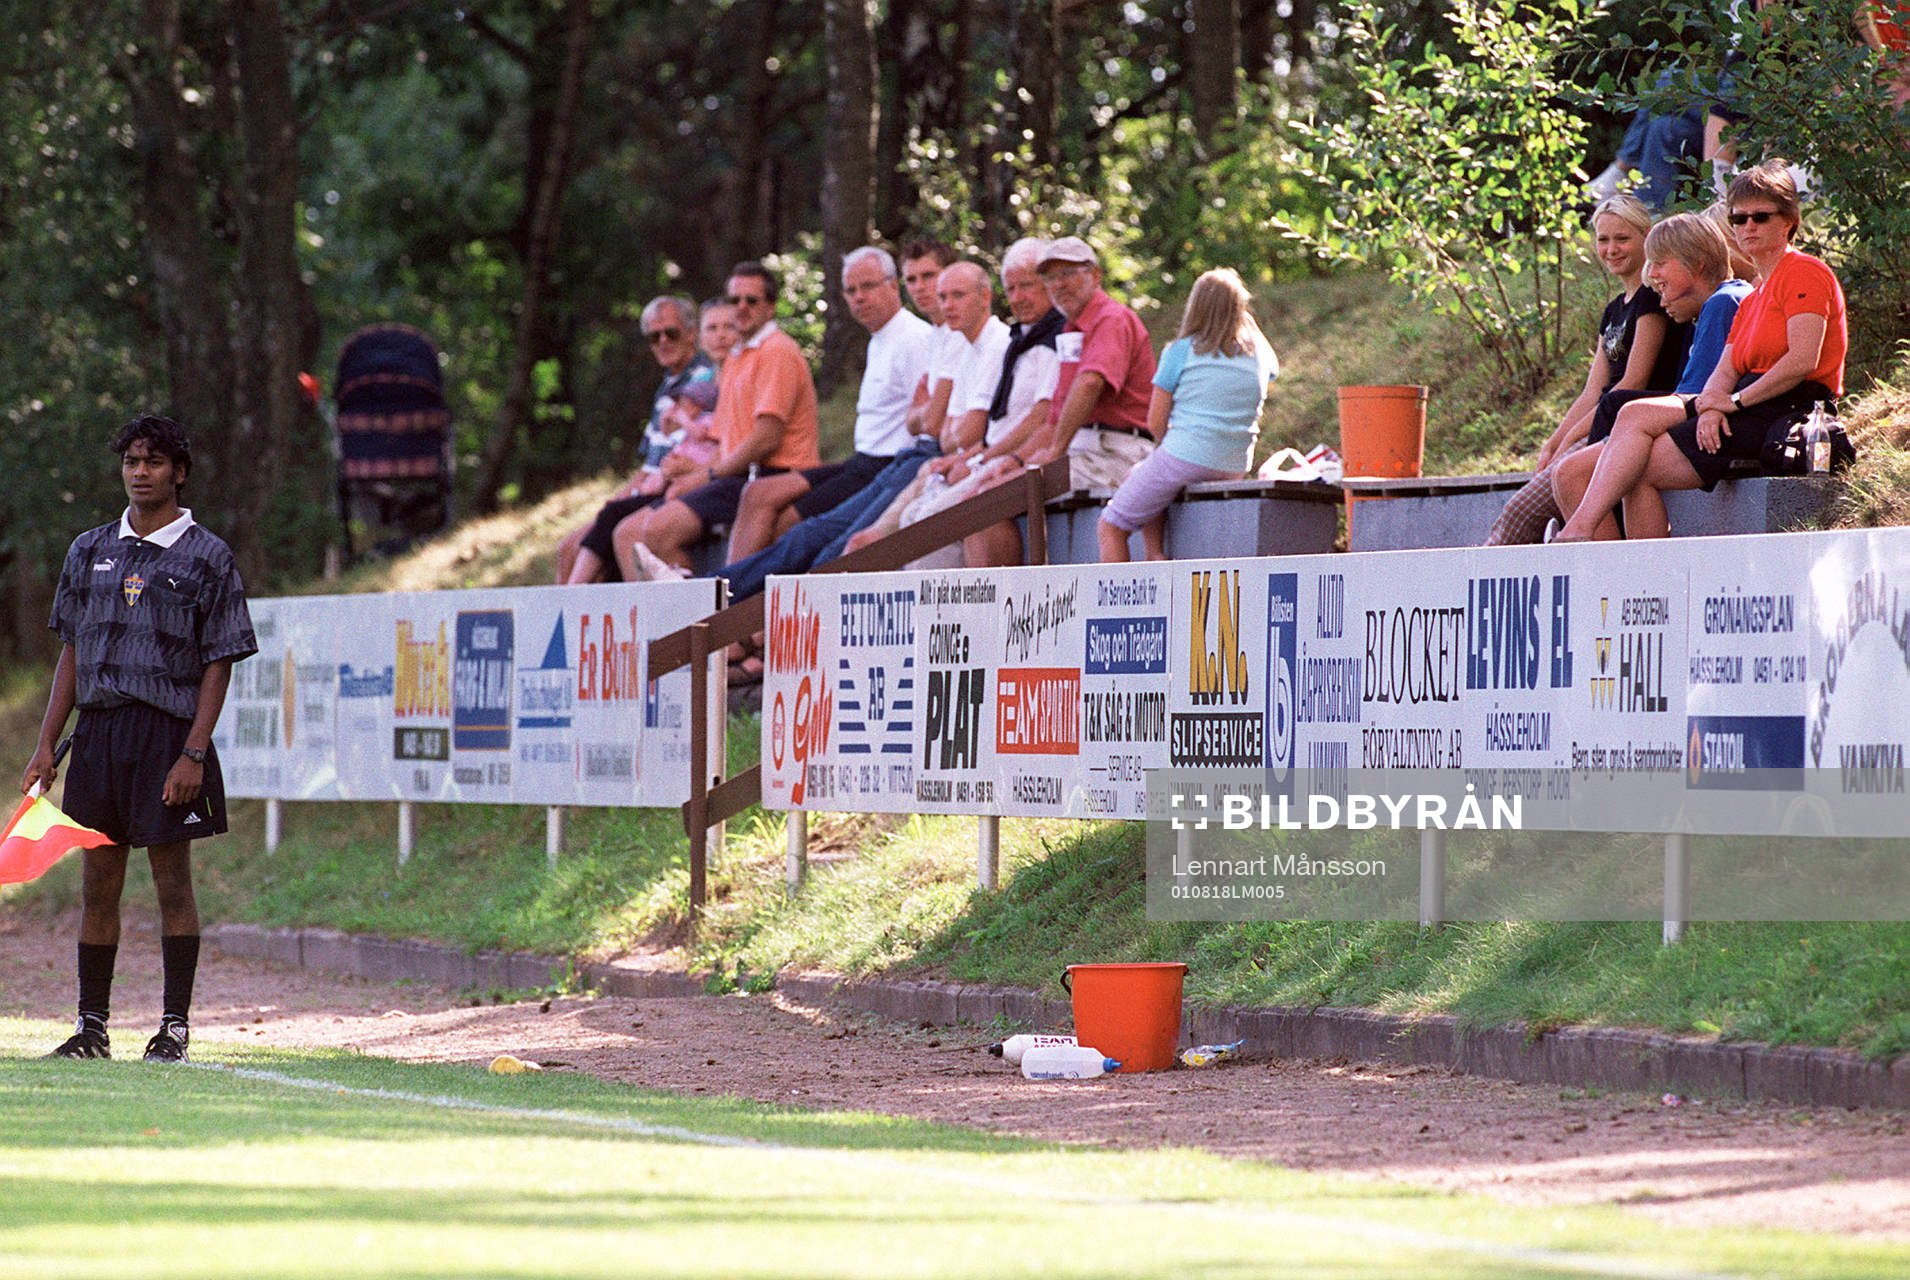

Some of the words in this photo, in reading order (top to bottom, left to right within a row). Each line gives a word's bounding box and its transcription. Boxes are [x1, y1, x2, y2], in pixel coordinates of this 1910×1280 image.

[951, 578, 962, 605] och
[963, 576, 996, 604] ventilation
[1109, 578, 1131, 607] Service
[1316, 573, 1345, 640] ALLTID
[769, 580, 820, 675] Vankiva
[840, 590, 916, 648] BETOMATIC
[928, 613, 962, 665] GÖINGE
[1189, 569, 1249, 706] K.N.
[1466, 573, 1541, 690] LEVINS
[1550, 574, 1574, 689] EL
[1089, 624, 1111, 671] Skog
[1111, 624, 1128, 663] och
[1128, 620, 1164, 671] Trädgård
[1362, 606, 1465, 706] BLOCKET
[1690, 649, 1743, 684] HÄSSLEHOLM
[1753, 655, 1772, 683] 0451
[867, 666, 886, 721] AB
[1296, 641, 1362, 724] LÅGPRISBENSIN
[1619, 632, 1668, 712] HALL
[999, 679, 1039, 745] TEAM
[1039, 679, 1079, 744] SPORTIA
[1084, 691, 1103, 742] T&K
[1105, 679, 1122, 742] SÅG
[1125, 691, 1132, 742] &
[1134, 691, 1166, 743] MOTOR
[1486, 702, 1551, 752] HÄSSLEHOLM
[1172, 719, 1262, 758] SLIPSERVICE
[1362, 720, 1443, 769] FÖRVALTNING
[1447, 729, 1463, 769] AB
[1634, 741, 1683, 781] sandprodukter
[1703, 732, 1746, 774] STATOIL
[1012, 768, 1062, 805] HÄSSLEHOLM
[1313, 742, 1348, 806] VANKIVA
[1502, 768, 1542, 800] PERSTORP
[1547, 760, 1571, 801] HÖÖR
[1839, 744, 1905, 794] VANKIVA
